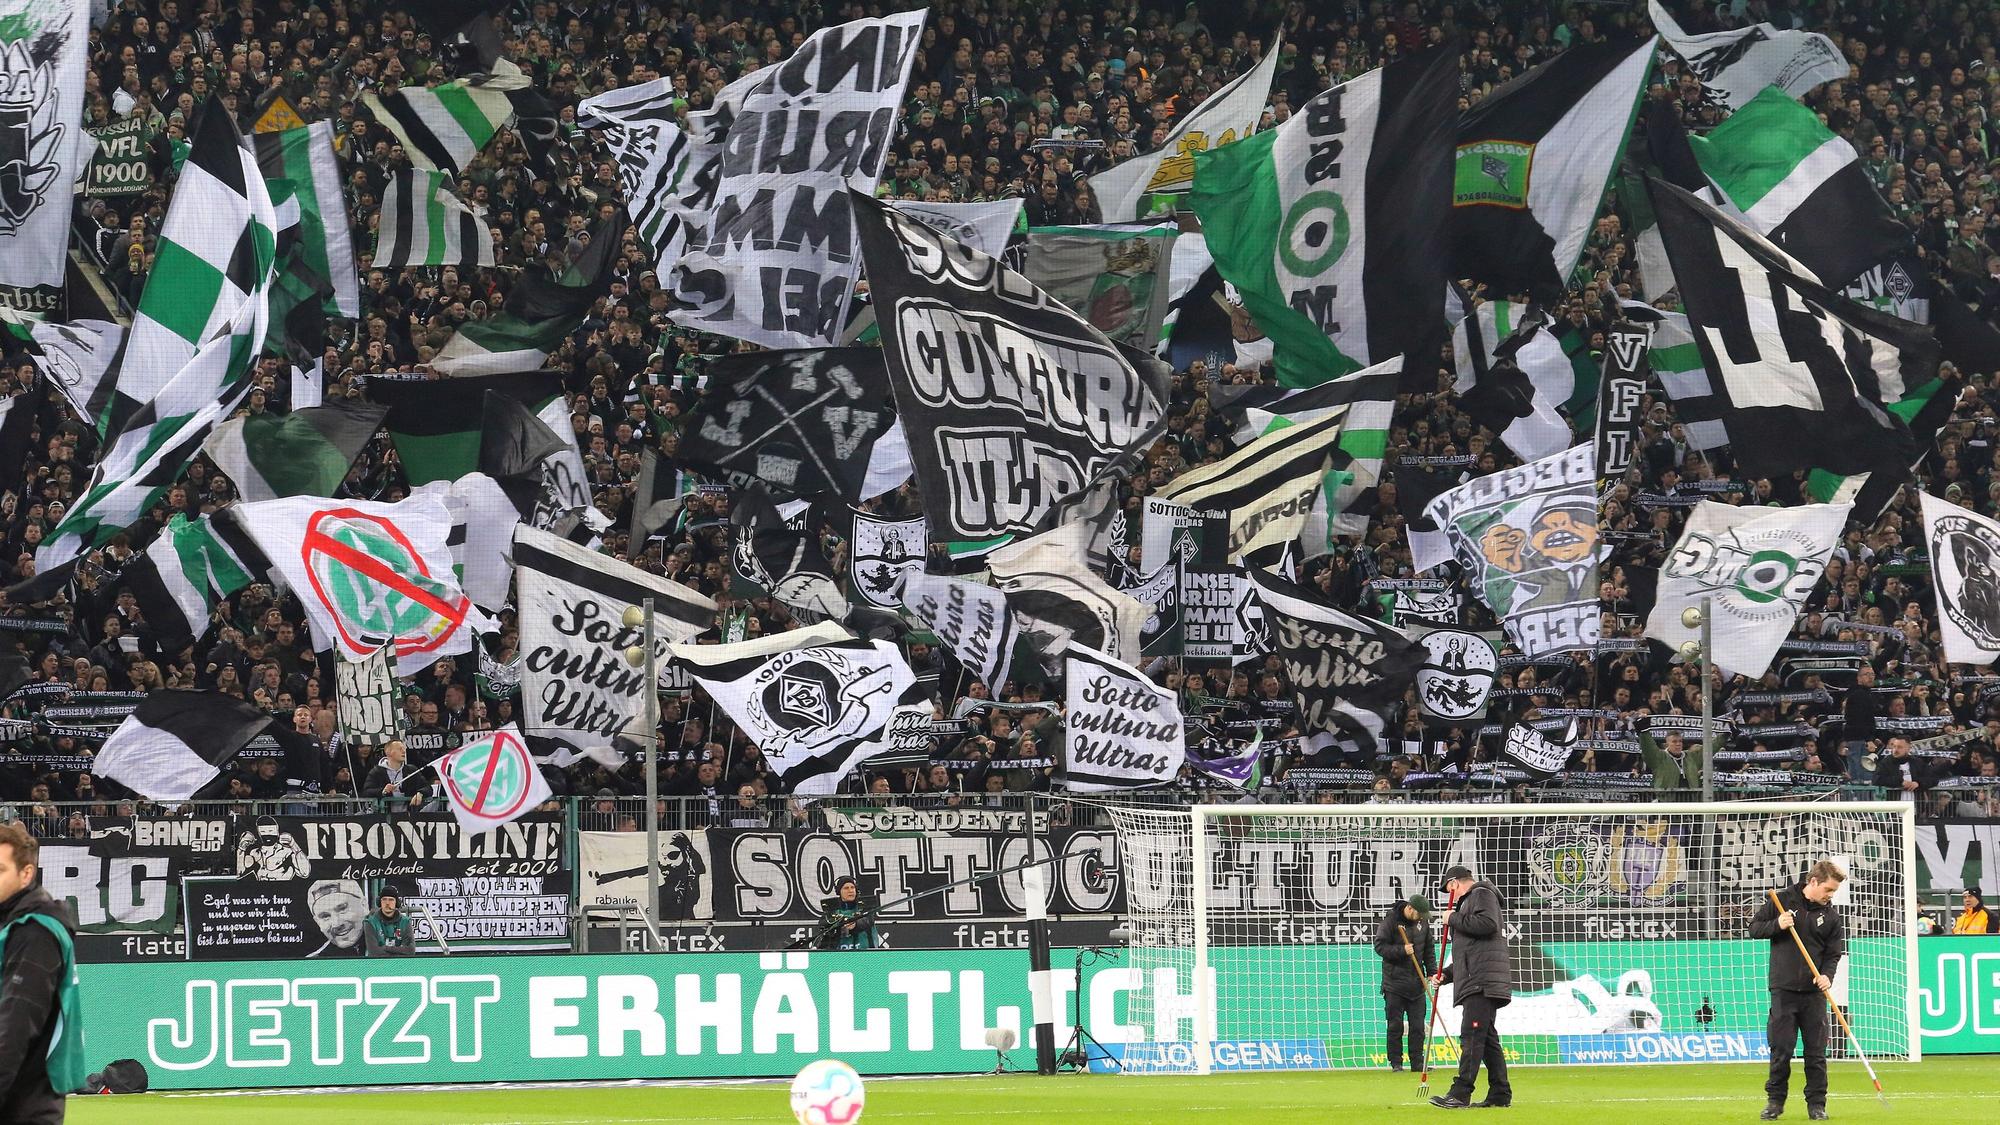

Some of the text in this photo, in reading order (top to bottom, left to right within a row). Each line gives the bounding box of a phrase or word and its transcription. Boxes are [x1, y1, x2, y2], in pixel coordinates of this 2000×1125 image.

[100, 135, 143, 158] VFL
[96, 161, 147, 183] 1900
[755, 652, 793, 685] 1900
[1083, 675, 1161, 712] Sotto
[1070, 708, 1179, 743] cultura
[1651, 718, 1730, 732] SOTTOCULURA
[1074, 735, 1169, 774] Ultras
[135, 820, 226, 846] BANDA
[191, 839, 221, 851] SUD
[302, 821, 561, 860] FRONTLINE
[342, 860, 559, 879] Ackerbande seit 2006
[417, 877, 544, 896] WIR WOLLEN
[203, 893, 231, 909] Egal
[147, 950, 1216, 1070] JETZT ERHÄLTLICH
[1622, 1034, 1748, 1061] JONGEN
